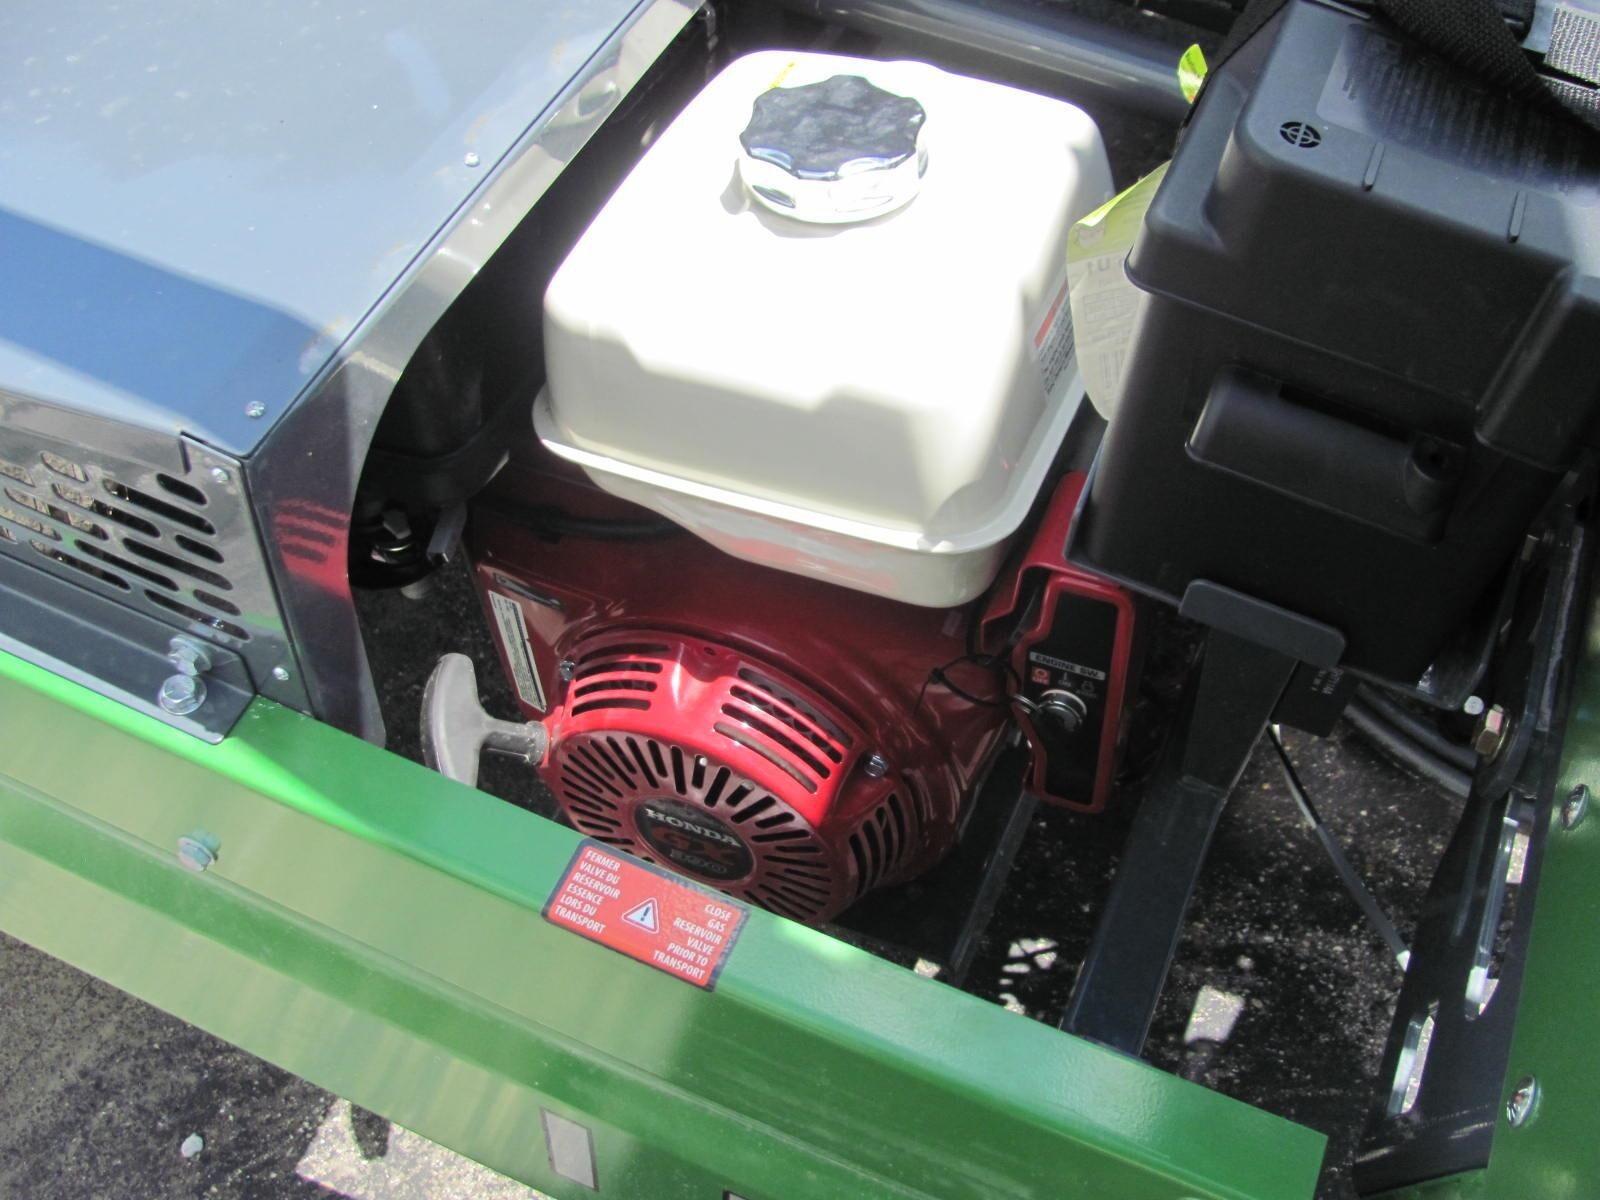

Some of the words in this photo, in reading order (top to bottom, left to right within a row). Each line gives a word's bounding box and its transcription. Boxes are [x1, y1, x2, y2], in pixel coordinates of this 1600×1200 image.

[644, 808, 742, 848] HONDA
[579, 860, 607, 879] VALVE
[605, 872, 621, 885] DU
[585, 850, 621, 872] FERMER
[560, 894, 583, 910] LORS
[582, 903, 598, 917] DU
[567, 882, 604, 905] ESSENCE
[554, 904, 606, 934] TRANSPORT
[704, 903, 732, 922] CLOSE
[673, 916, 722, 945] RESERVOIR
[707, 918, 726, 933] GAS
[666, 942, 696, 961] PRIOR
[696, 953, 709, 967] TO
[687, 936, 715, 956] VALVE
[652, 949, 706, 979] TRANSPORT
